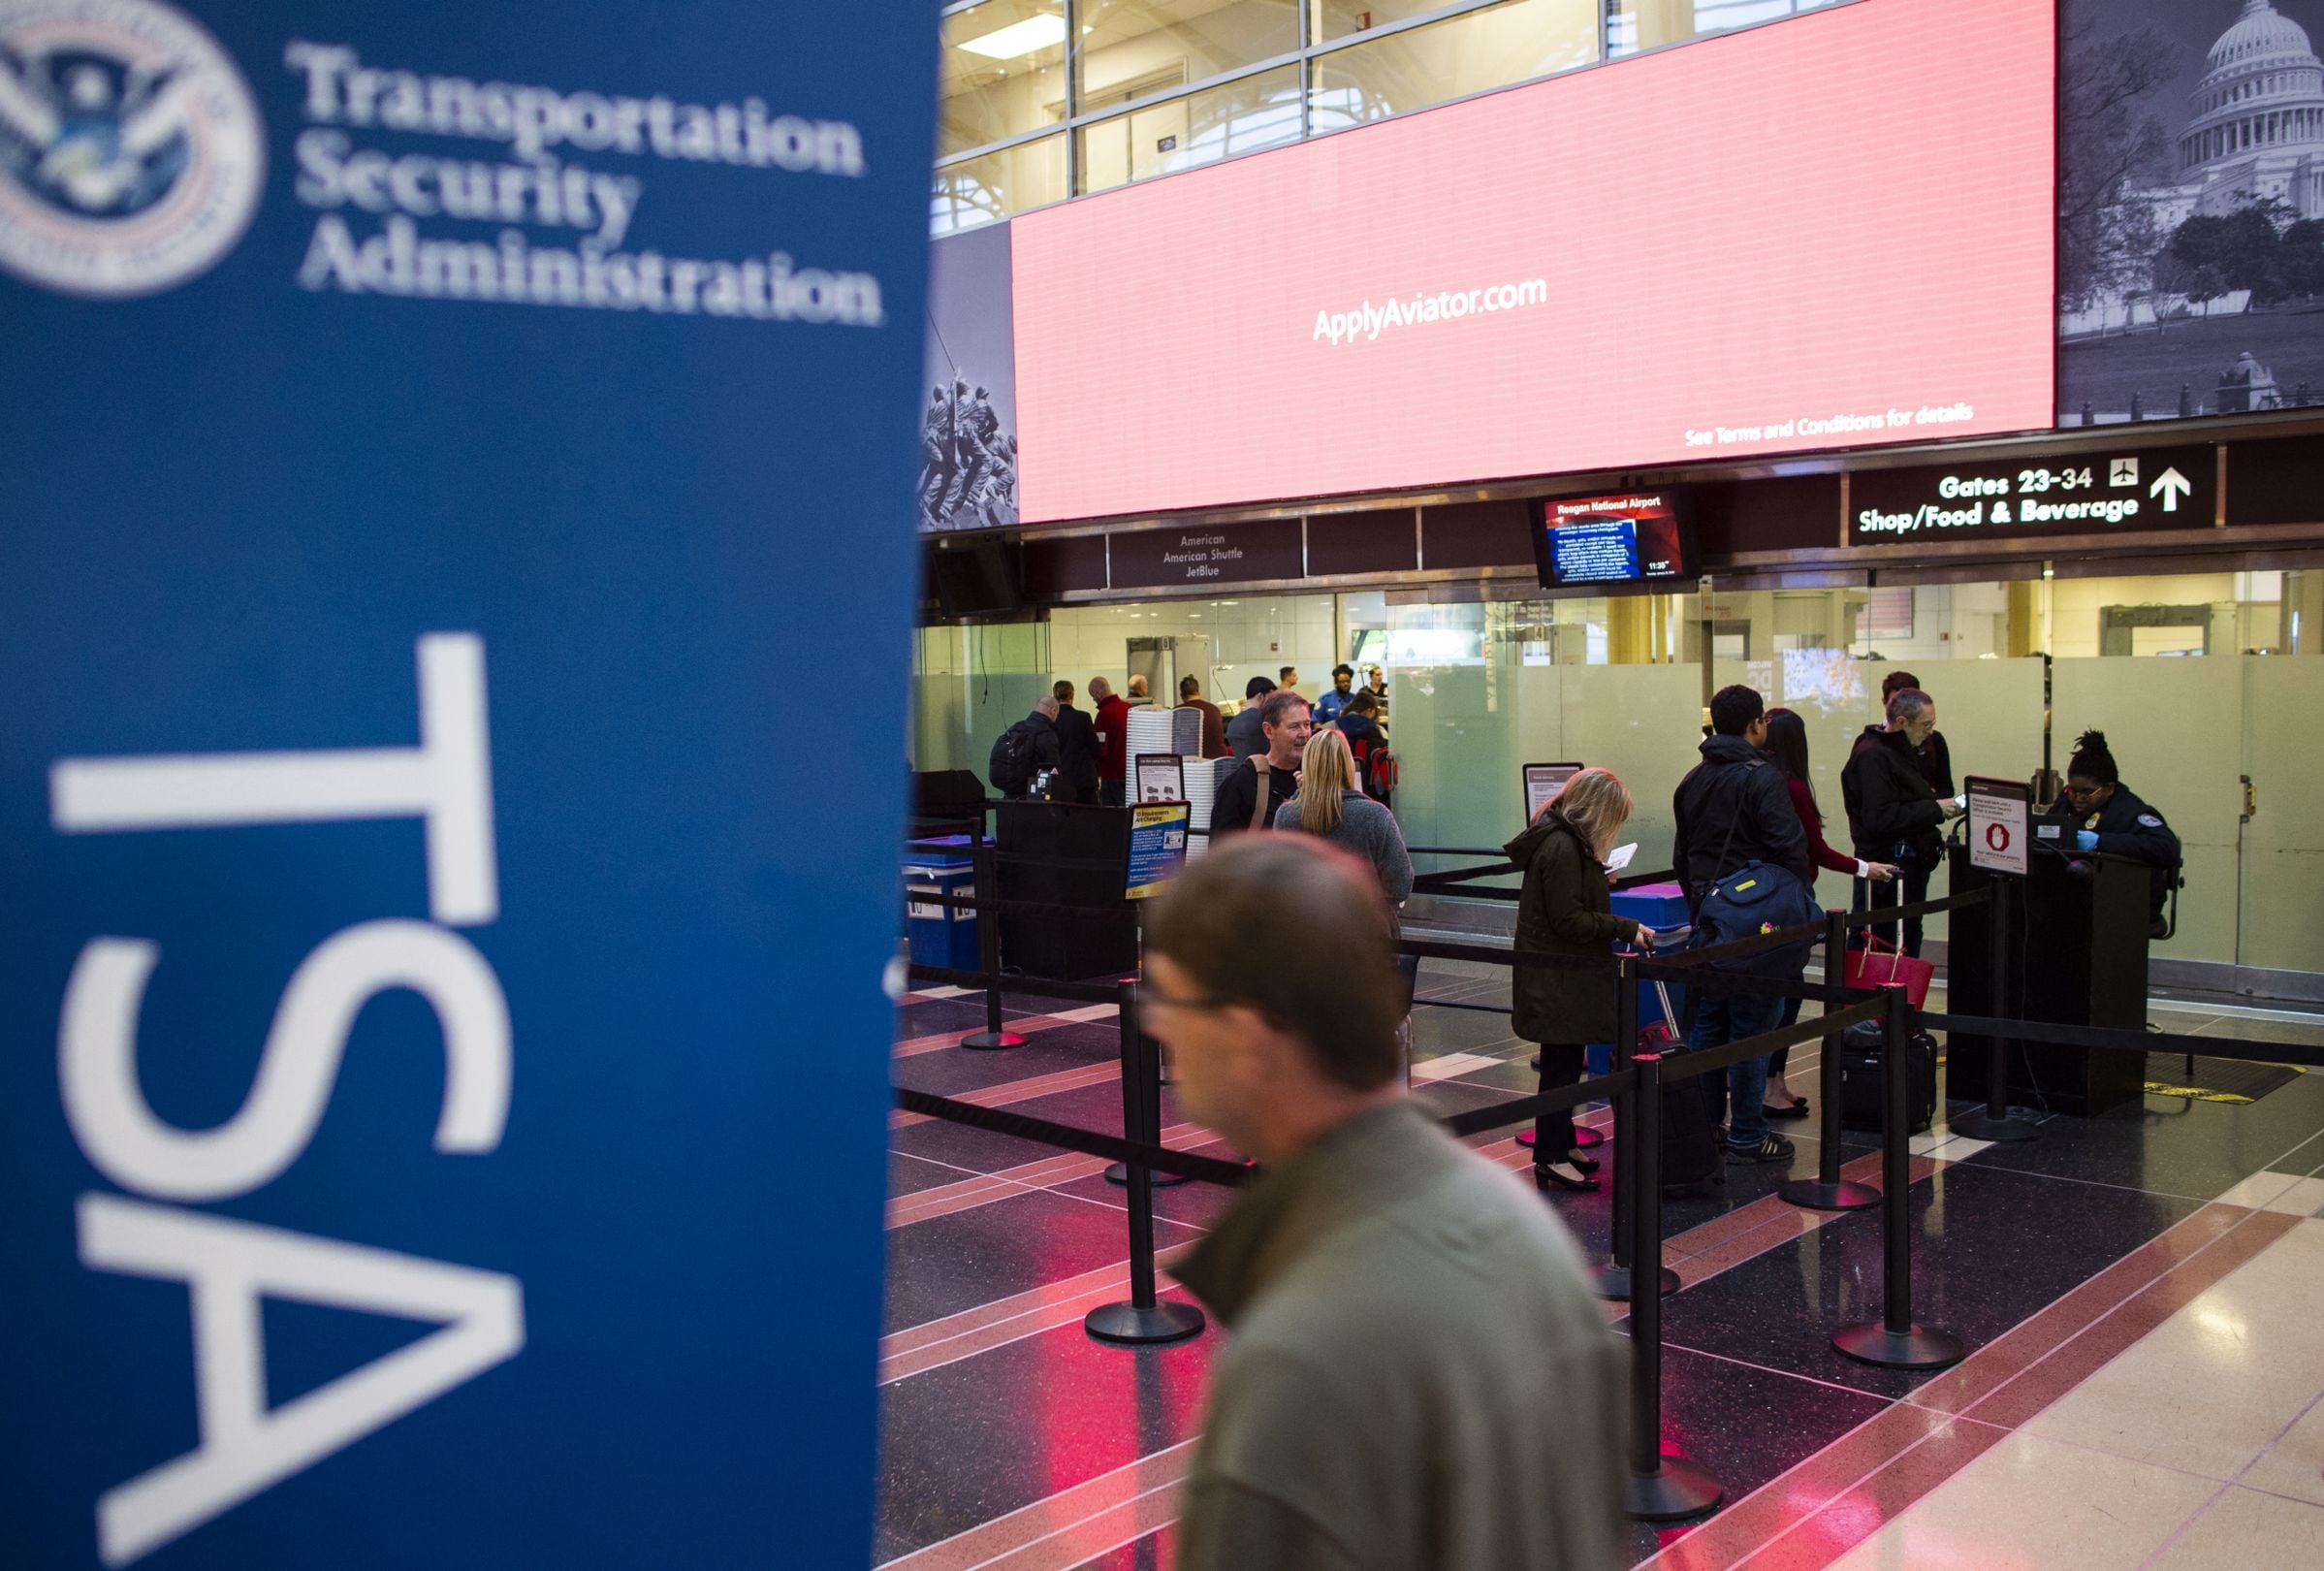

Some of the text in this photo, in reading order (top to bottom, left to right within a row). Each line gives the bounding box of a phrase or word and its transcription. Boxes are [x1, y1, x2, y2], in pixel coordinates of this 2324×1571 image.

[286, 42, 863, 176] Transportation
[297, 129, 641, 249] Security
[299, 215, 883, 325] Administration
[1313, 279, 1546, 345] ApplyAviator.com
[1685, 401, 1974, 446] See Terms and Conditions for details
[1939, 467, 2093, 498] Gates 23-34
[1557, 497, 1661, 515] Reagan National Airport
[1859, 499, 2139, 534] Shop/Food & Beverage
[1163, 547, 1243, 563] American Shuttle
[1180, 535, 1226, 547] American
[1186, 565, 1220, 578] JetBlue
[49, 631, 525, 1569] TSA
